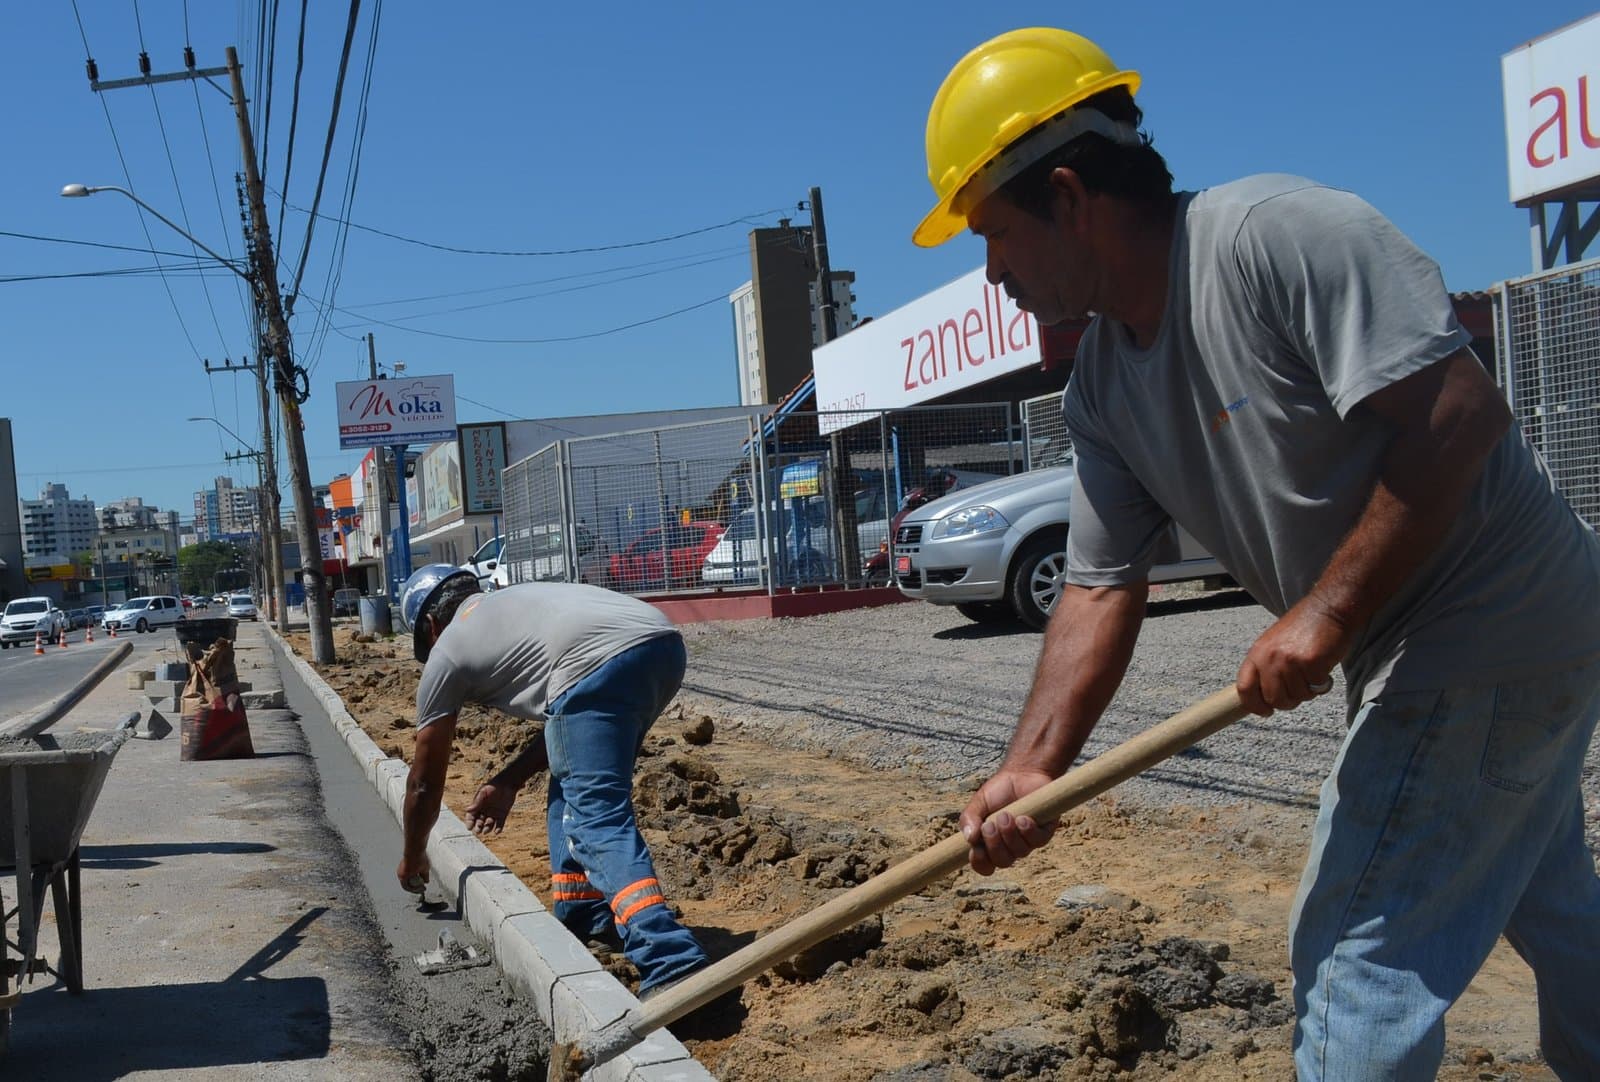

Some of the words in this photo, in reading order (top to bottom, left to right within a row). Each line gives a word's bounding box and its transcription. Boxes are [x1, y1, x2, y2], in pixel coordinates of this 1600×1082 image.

[900, 283, 1032, 391] zanella
[350, 384, 442, 420] Moka
[483, 428, 496, 487] TINTAS
